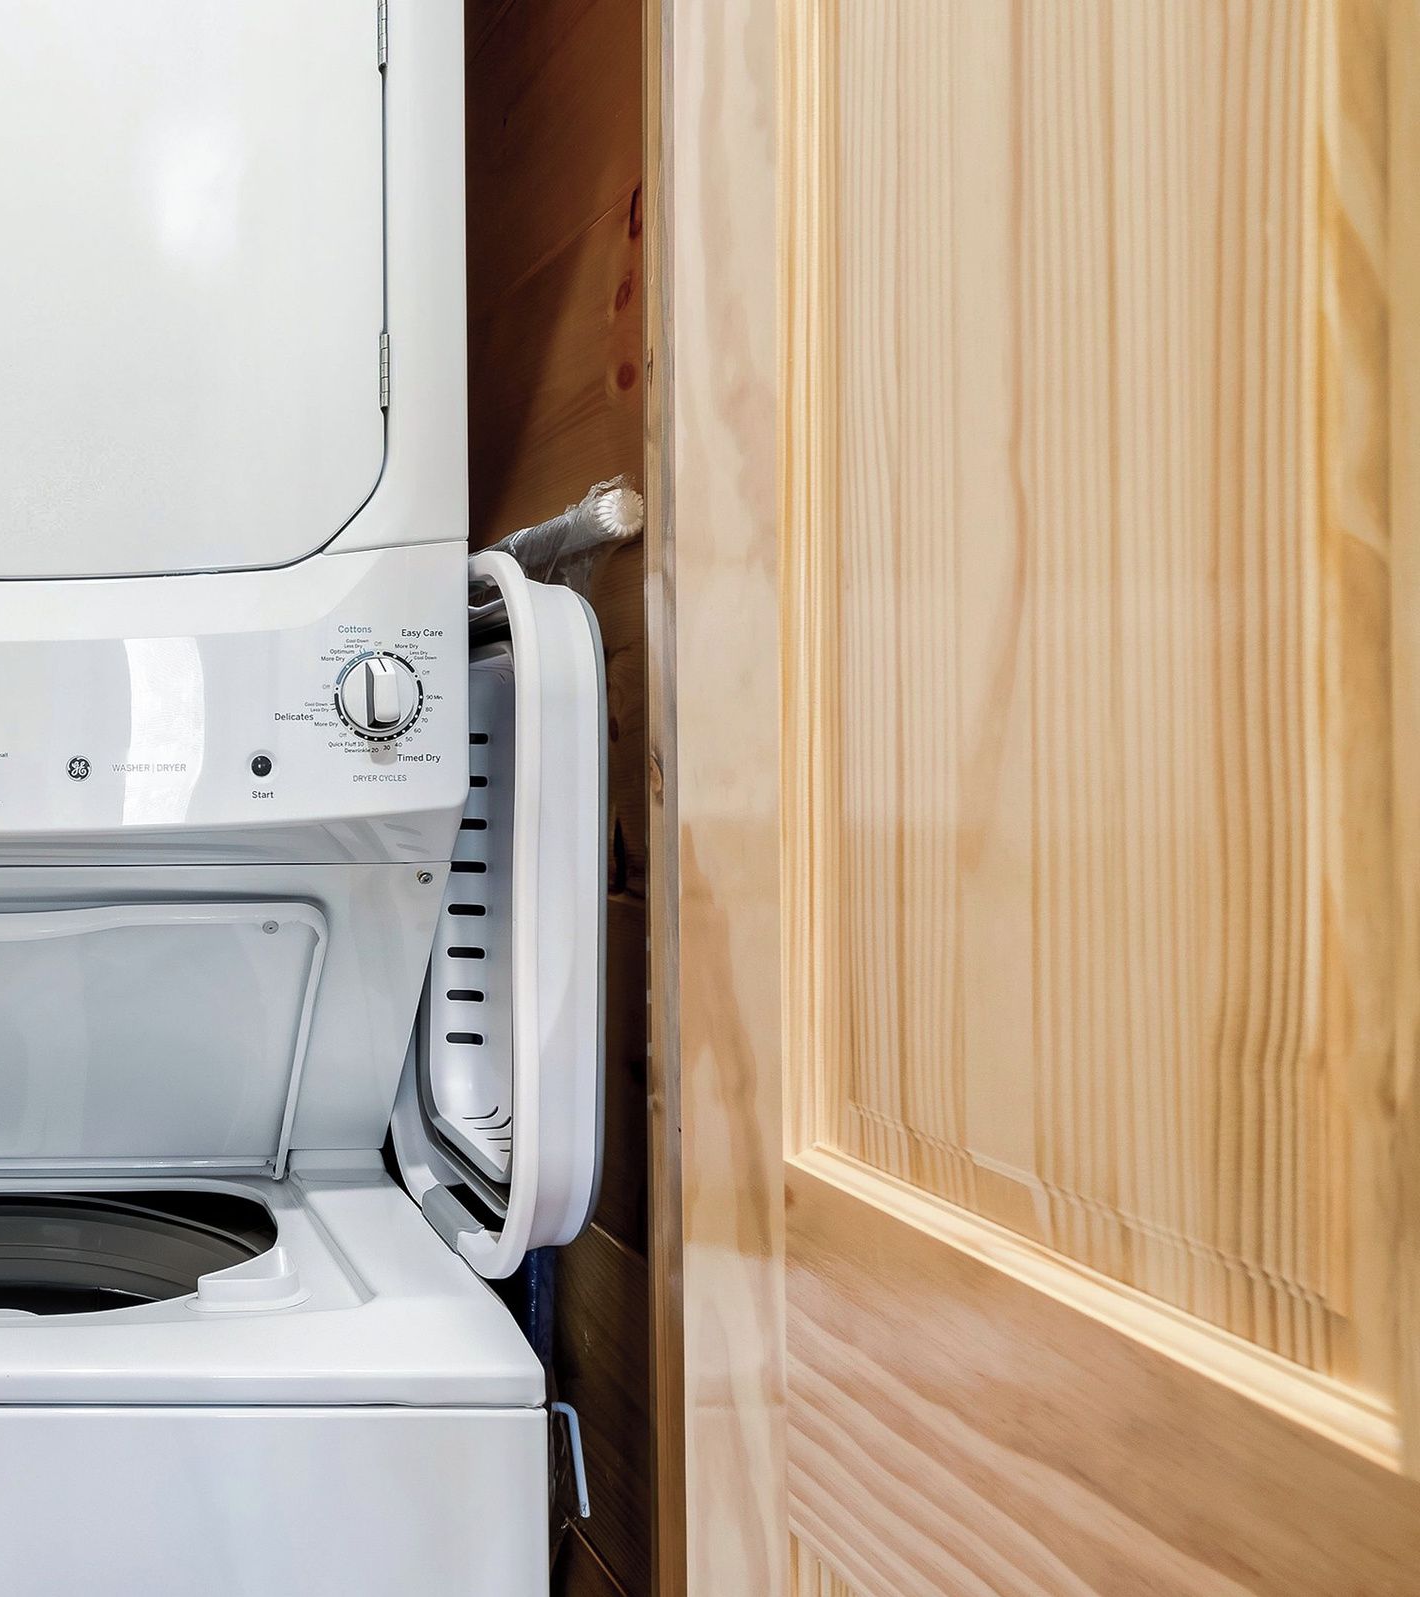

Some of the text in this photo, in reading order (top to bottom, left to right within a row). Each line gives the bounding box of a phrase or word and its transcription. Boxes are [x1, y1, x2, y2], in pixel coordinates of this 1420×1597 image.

[338, 625, 372, 634] Cottons
[401, 629, 443, 638] Easy Care
[274, 713, 314, 721] Delicates
[397, 754, 441, 763] Timed Dry
[67, 757, 91, 780] GE
[112, 763, 186, 772] WASHER DRYER
[353, 774, 407, 782] DRYER CYCLES
[252, 790, 274, 799] Start
